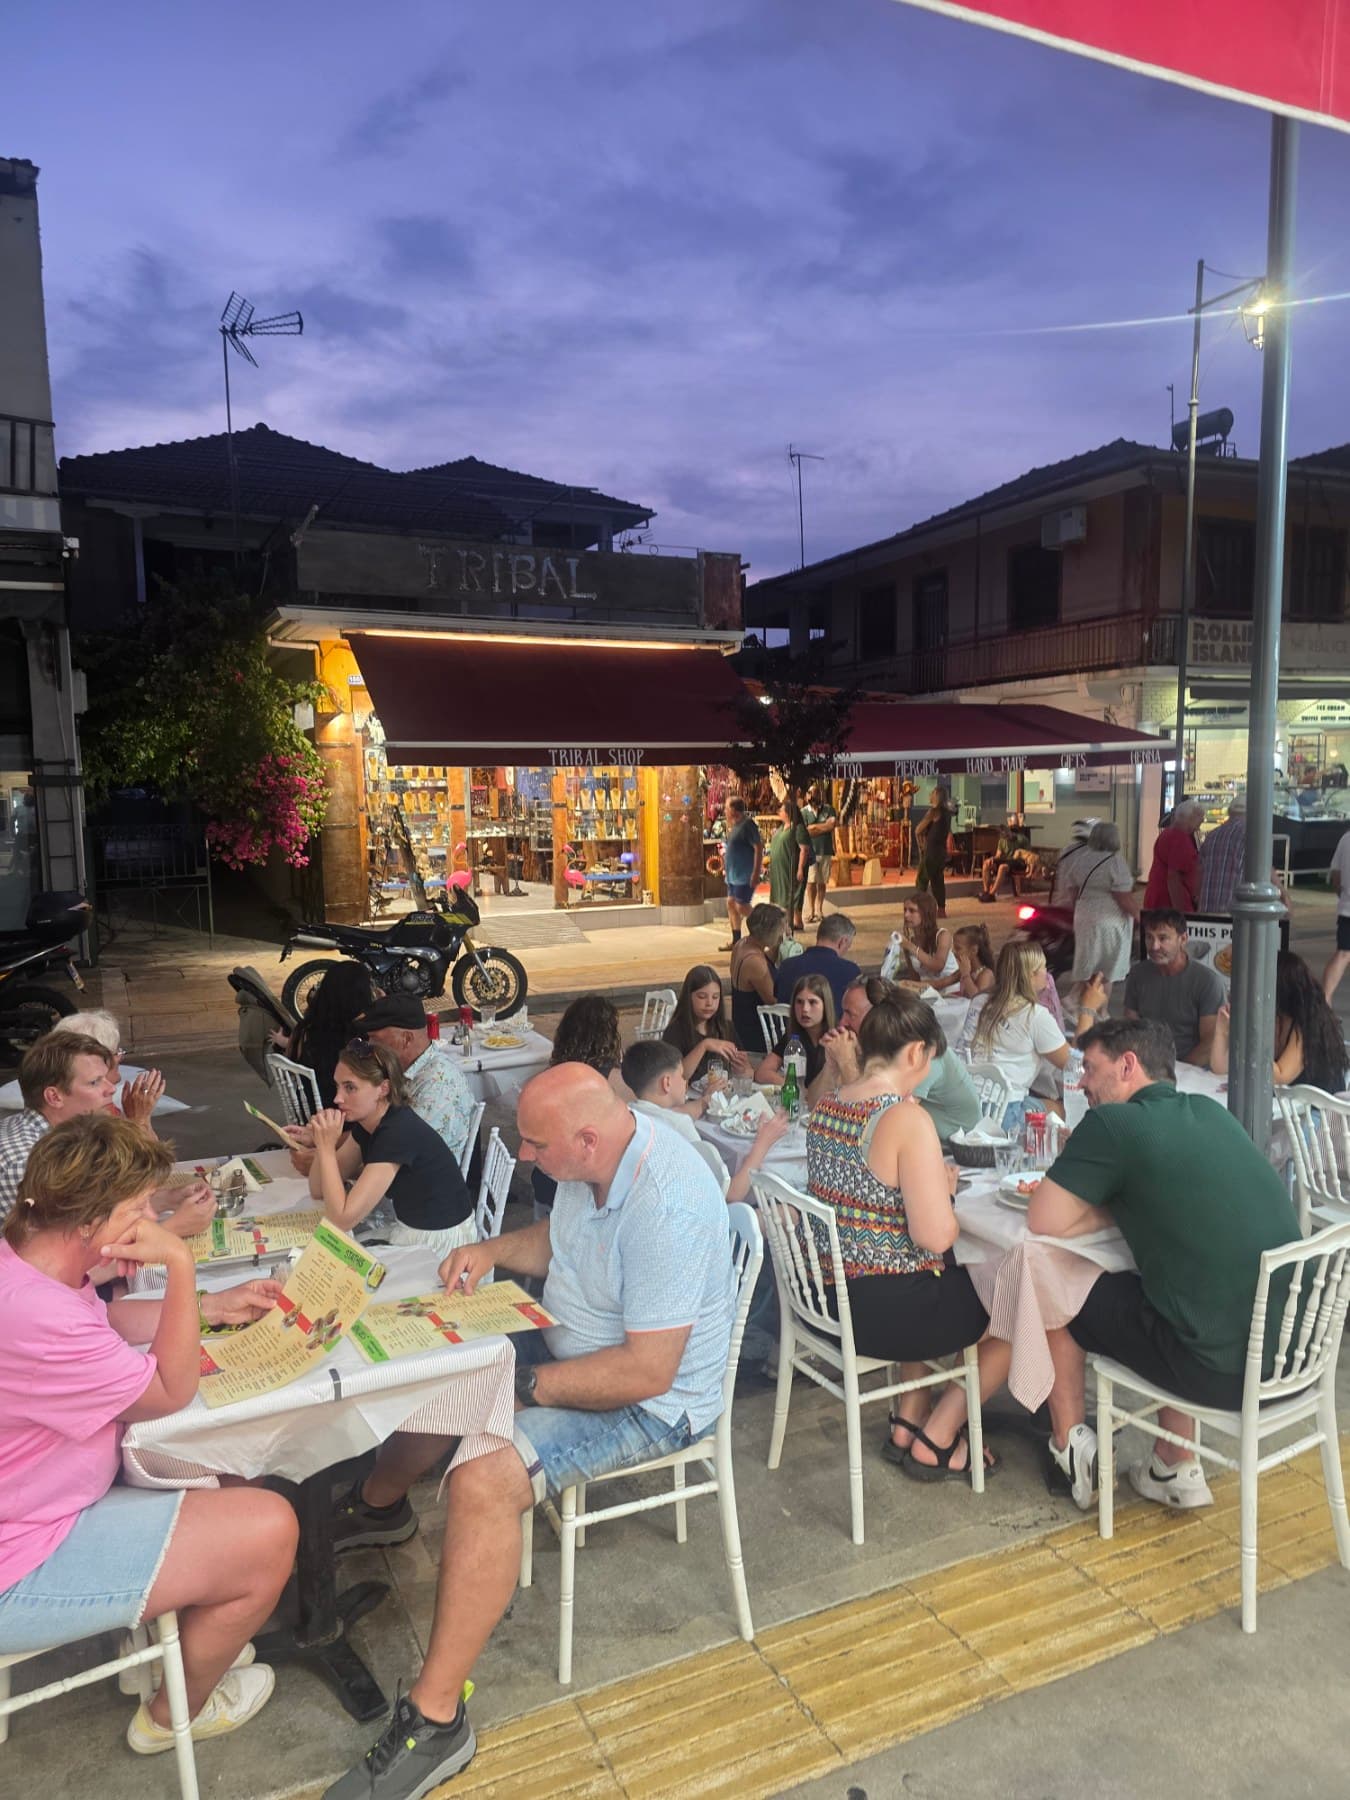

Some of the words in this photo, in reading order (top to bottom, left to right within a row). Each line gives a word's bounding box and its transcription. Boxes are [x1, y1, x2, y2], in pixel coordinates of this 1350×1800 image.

[418, 544, 598, 600] TRIBAL
[548, 748, 603, 766] TRIBAL
[608, 748, 645, 766] SHOP
[895, 759, 940, 777] PIERCING
[966, 757, 994, 776] HAND
[1000, 755, 1029, 772] MADE
[1060, 752, 1087, 769] GIFTS
[1187, 926, 1217, 939] THIS
